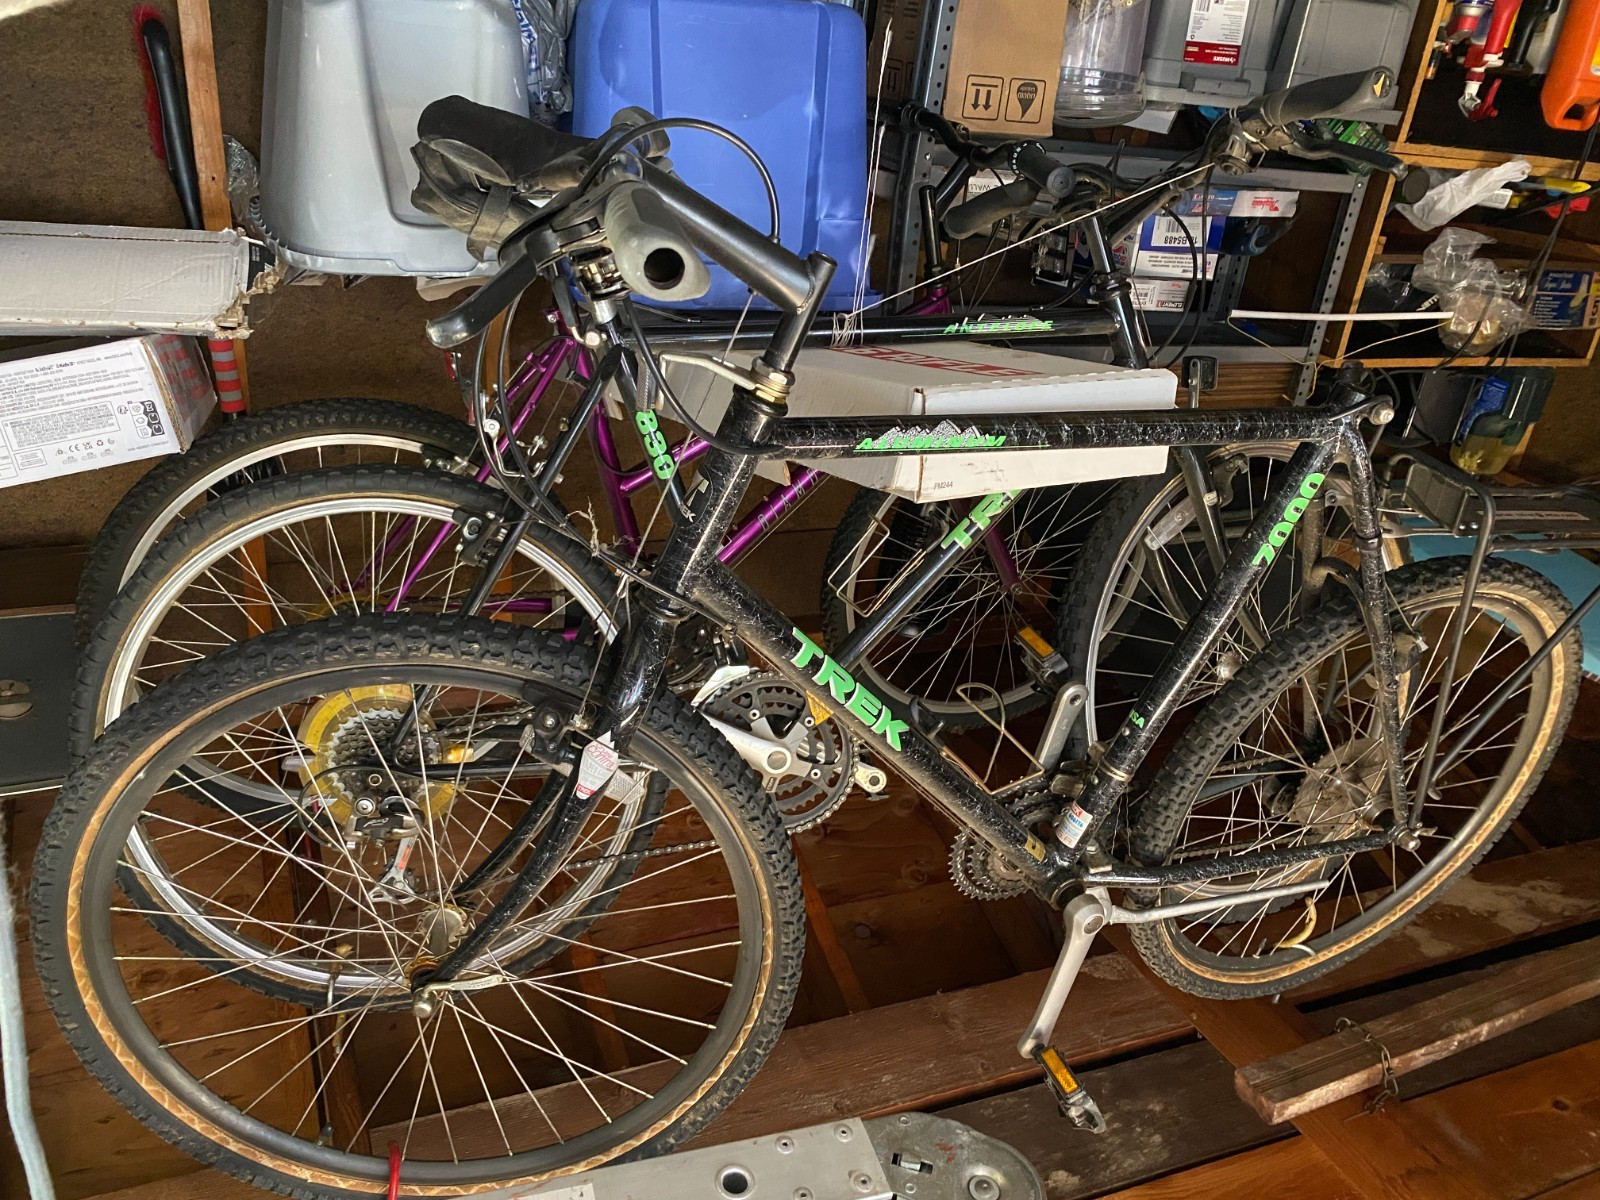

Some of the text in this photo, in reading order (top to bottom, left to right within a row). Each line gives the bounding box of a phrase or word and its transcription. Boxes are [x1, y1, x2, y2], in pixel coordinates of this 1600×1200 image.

[1018, 92, 1036, 100] LIQUID
[1163, 235, 1198, 245] 1B5488
[943, 321, 1053, 334] ANTELOPE
[635, 409, 675, 480] 830
[854, 436, 1006, 450] ALUMINUM
[934, 481, 953, 490] PM244
[940, 489, 1021, 550] TR
[1251, 473, 1325, 566] 7000
[790, 627, 910, 752] TREK
